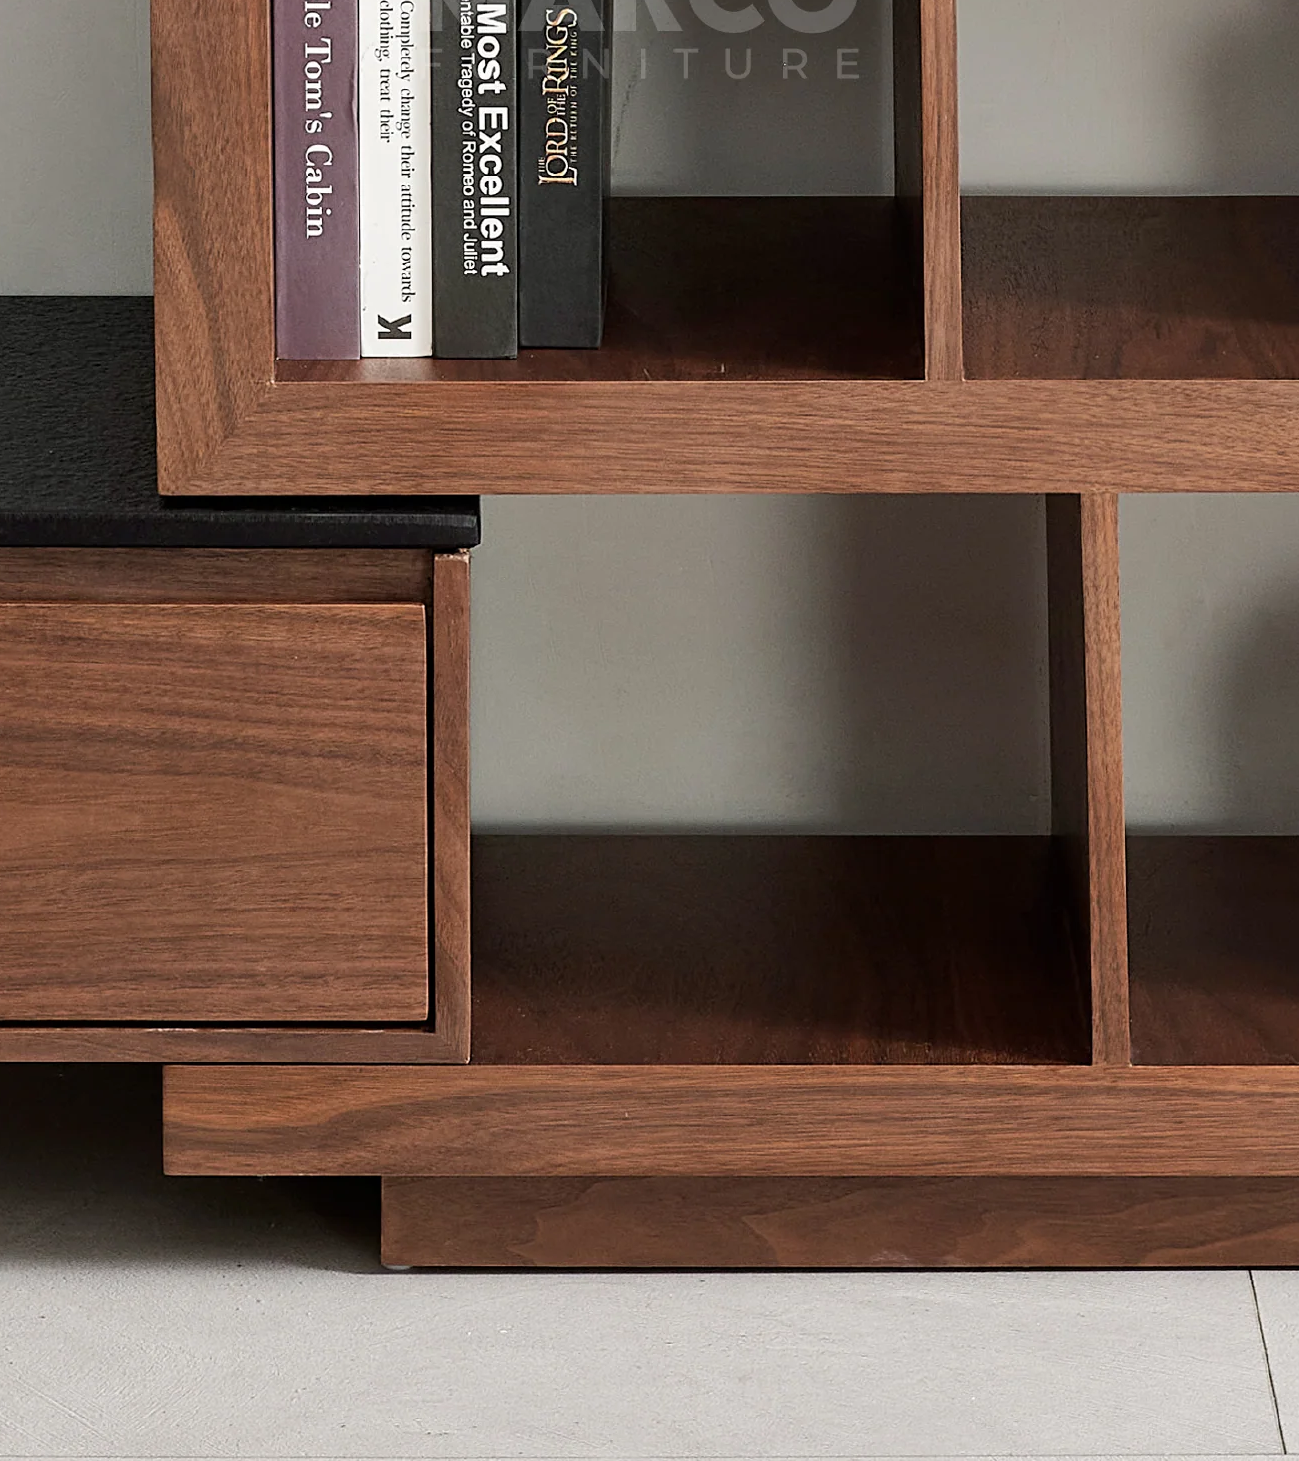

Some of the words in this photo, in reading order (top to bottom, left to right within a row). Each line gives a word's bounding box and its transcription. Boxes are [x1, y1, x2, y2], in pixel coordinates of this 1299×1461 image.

[374, 0, 394, 62] clothing,
[395, 0, 416, 82] Completely
[476, 3, 508, 96] Most
[541, 7, 579, 98] RINGS
[569, 31, 579, 57] KING
[303, 37, 334, 135] Tom's
[380, 69, 391, 101] treat
[457, 53, 477, 117] Tragedy
[569, 61, 579, 80] THE
[569, 85, 579, 98] OF
[380, 109, 394, 143] their
[395, 88, 416, 140] change
[547, 96, 558, 114] OF
[556, 93, 567, 117] THE
[569, 101, 579, 142] RETURN
[461, 121, 477, 136] of
[401, 145, 416, 179] their
[462, 140, 477, 197] Romeo
[538, 116, 579, 187] LORD
[569, 145, 579, 164] THE
[304, 144, 334, 239] Cabin
[401, 184, 417, 241] attitude
[477, 105, 511, 277] Excellent
[463, 199, 478, 230] and
[401, 247, 417, 303] towards
[463, 233, 479, 276] Juliet
[377, 313, 412, 340] K
